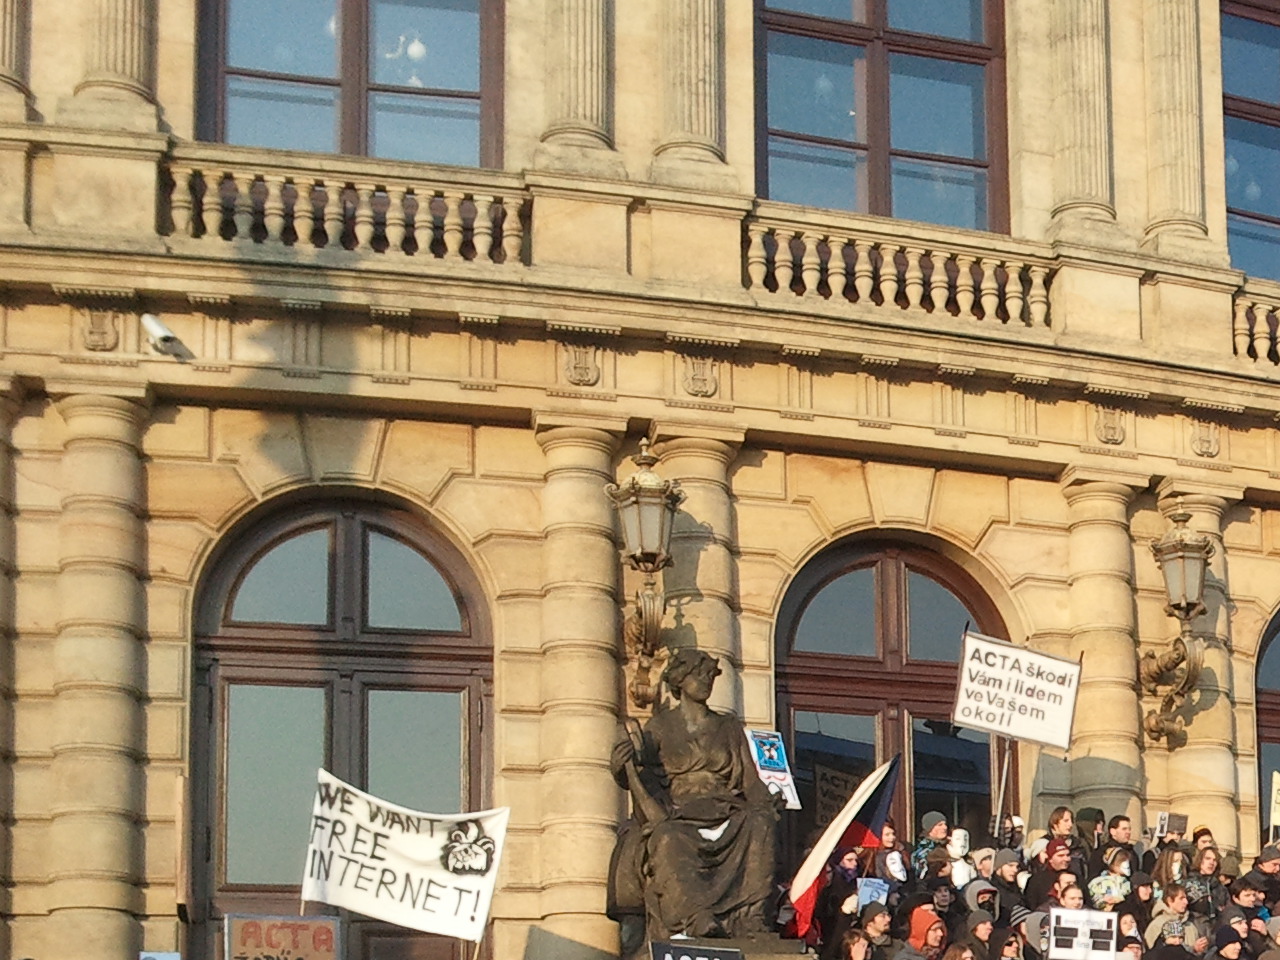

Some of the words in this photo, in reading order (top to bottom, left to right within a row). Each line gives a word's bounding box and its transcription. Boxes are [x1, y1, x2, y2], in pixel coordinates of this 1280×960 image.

[968, 667, 1003, 690] Vám
[1014, 679, 1063, 706] lidem
[970, 647, 1022, 673] ACTA
[1026, 662, 1074, 688] škodí
[961, 705, 1013, 727] okolí
[965, 688, 983, 702] ve
[986, 690, 1046, 721] Vašem
[318, 782, 359, 815] WE
[364, 802, 443, 838] WANT
[311, 815, 391, 862] FREE
[309, 849, 481, 922] INTERNET!
[240, 920, 333, 953] ACTA
